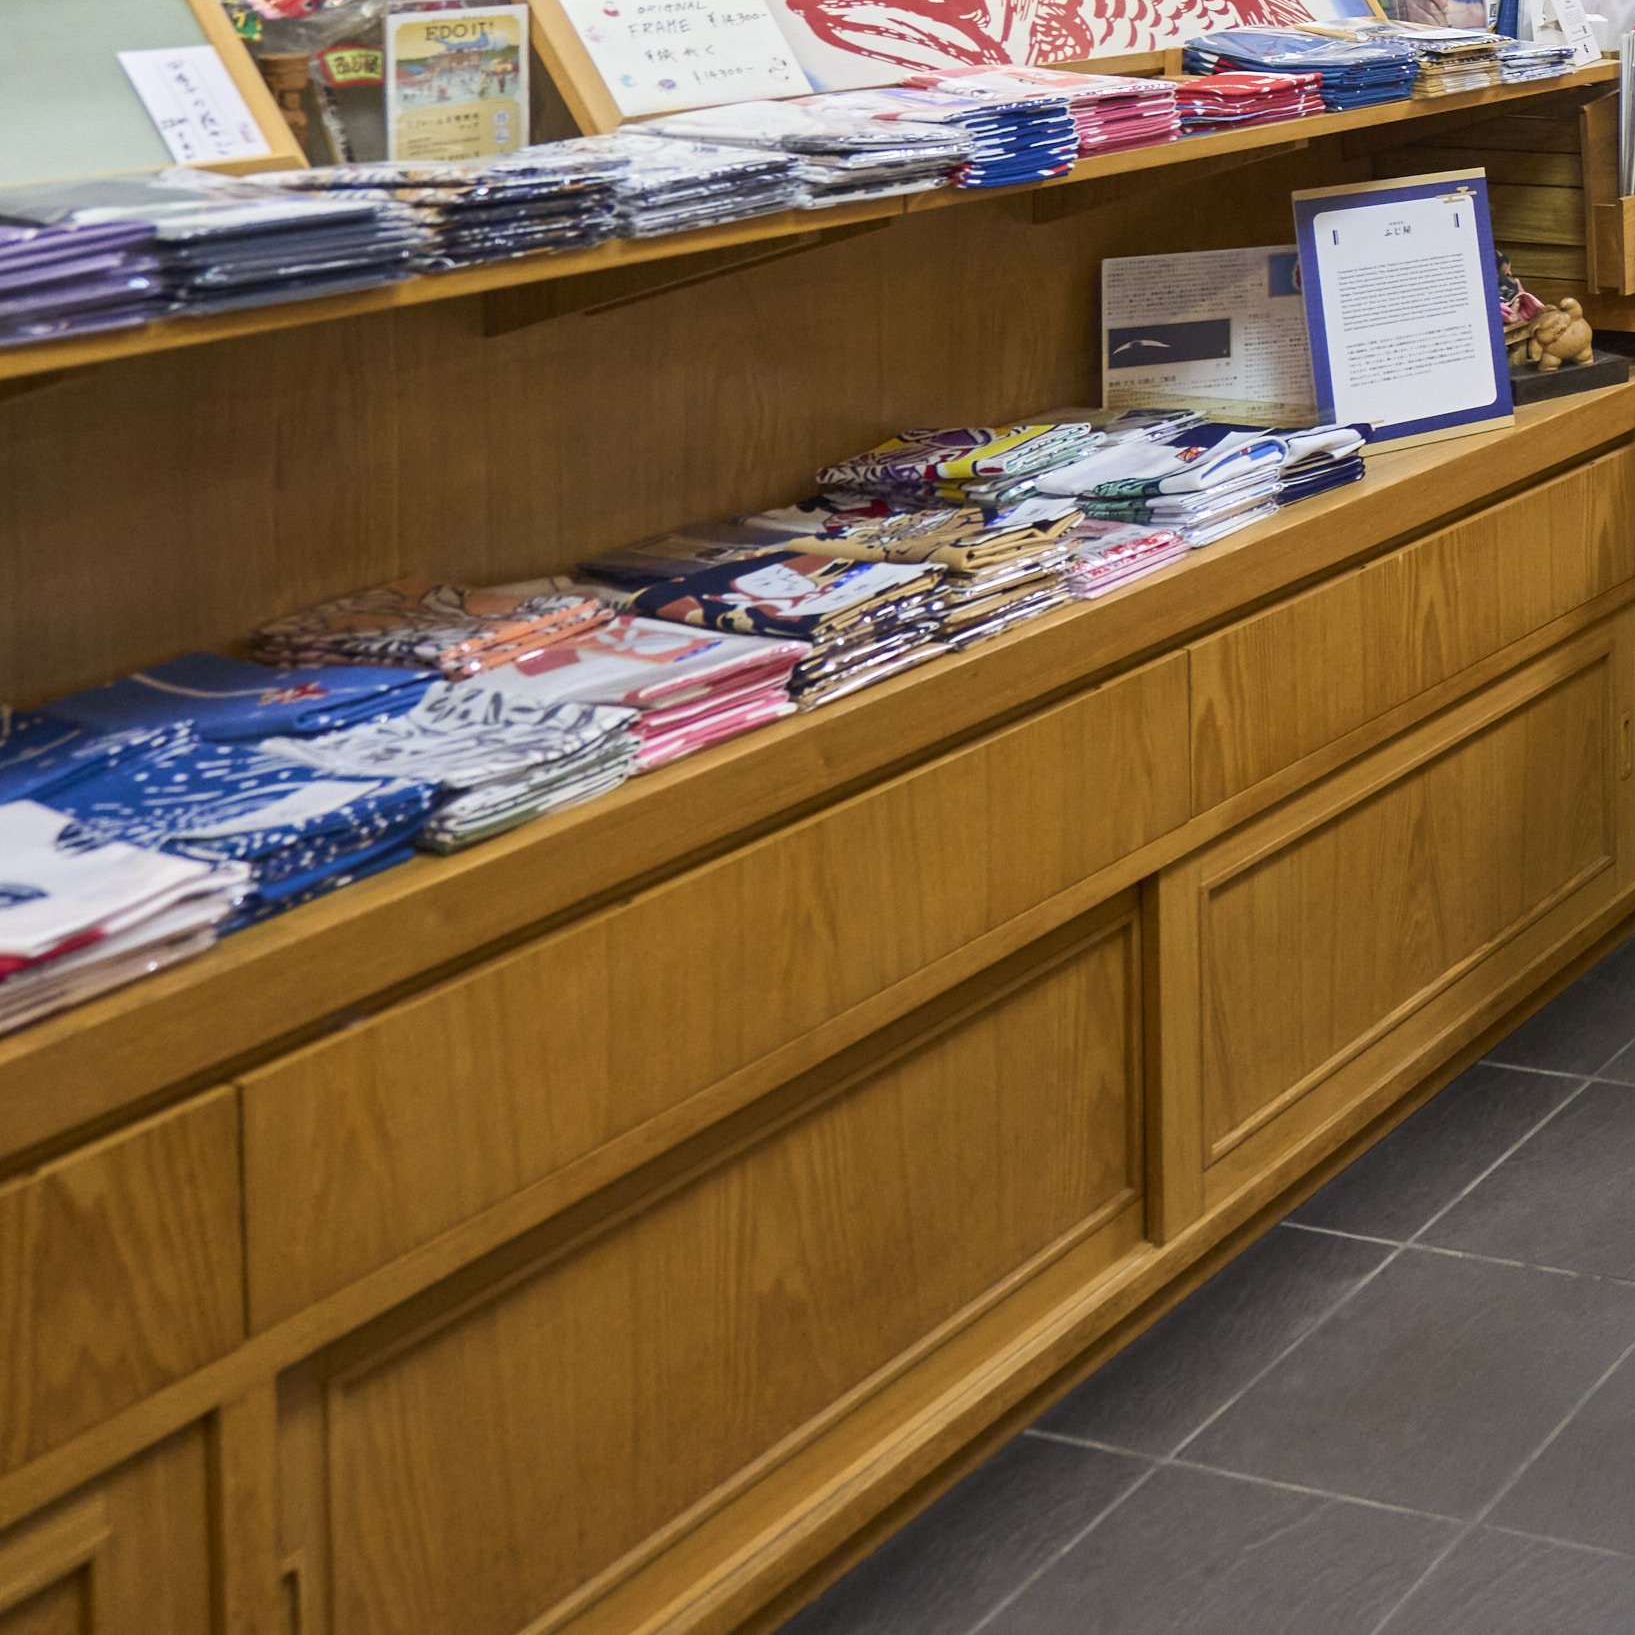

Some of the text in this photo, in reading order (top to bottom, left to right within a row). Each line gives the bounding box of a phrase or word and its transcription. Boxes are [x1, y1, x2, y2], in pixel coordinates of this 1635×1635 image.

[638, 1, 709, 14] ORIGINAL
[425, 24, 466, 41] EDO
[628, 18, 691, 38] FRAME
